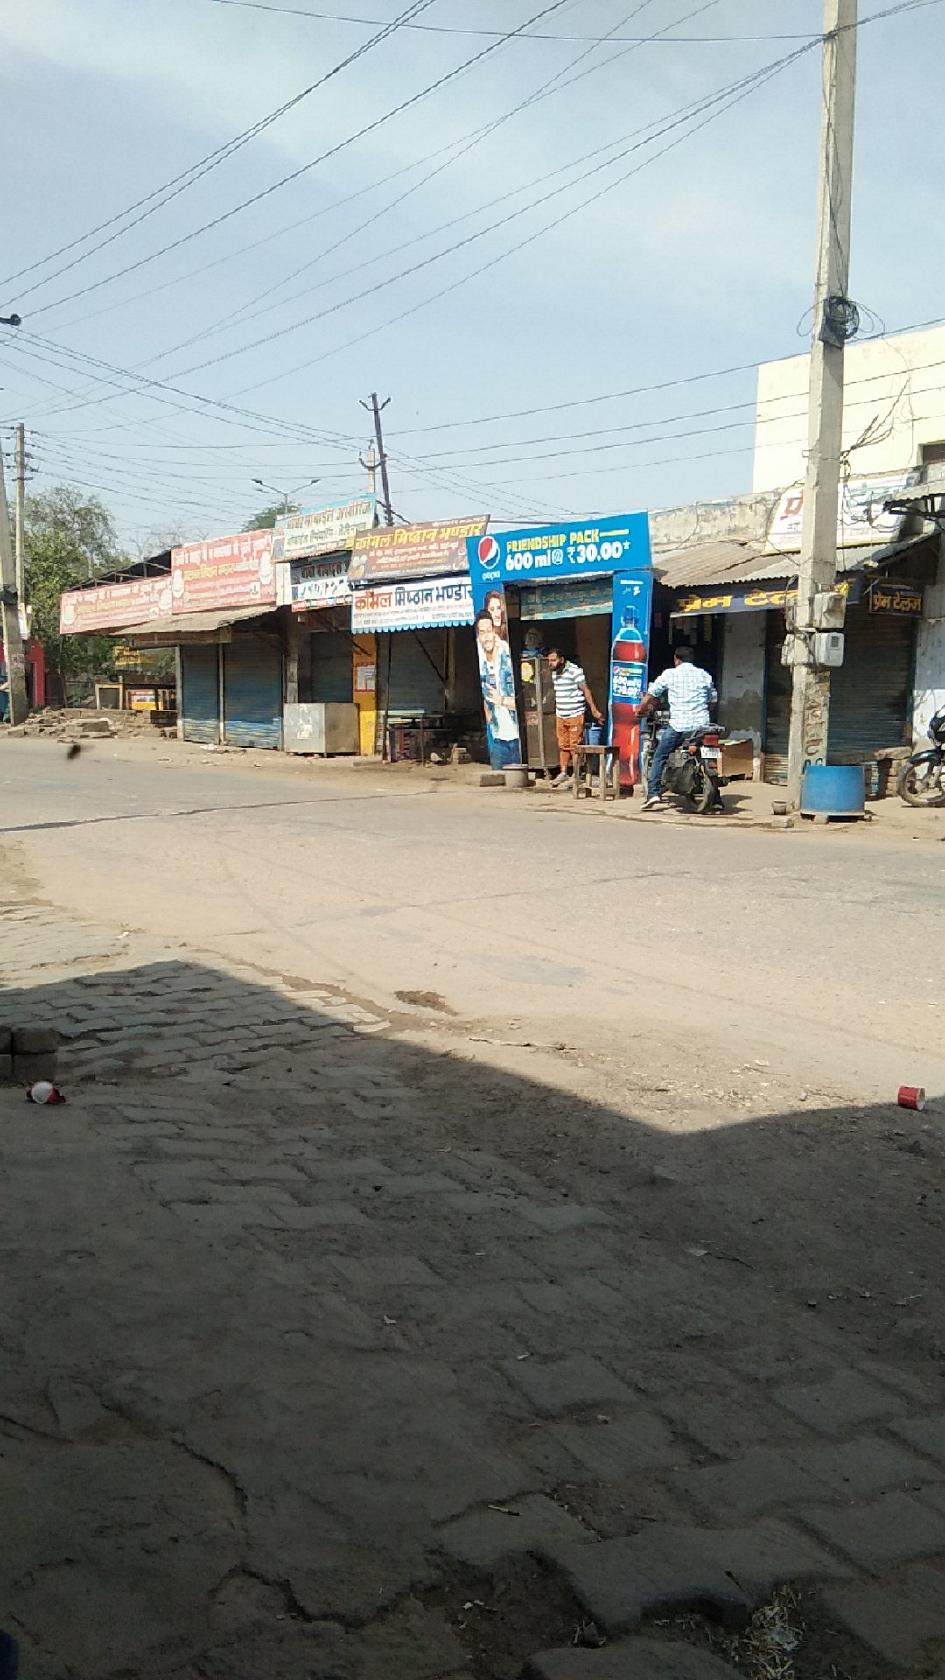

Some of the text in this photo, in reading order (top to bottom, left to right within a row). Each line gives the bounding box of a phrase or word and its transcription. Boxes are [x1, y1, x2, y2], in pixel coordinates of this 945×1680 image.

[506, 529, 600, 553] FRIENDSHIP PACK
[505, 552, 533, 571] 600
